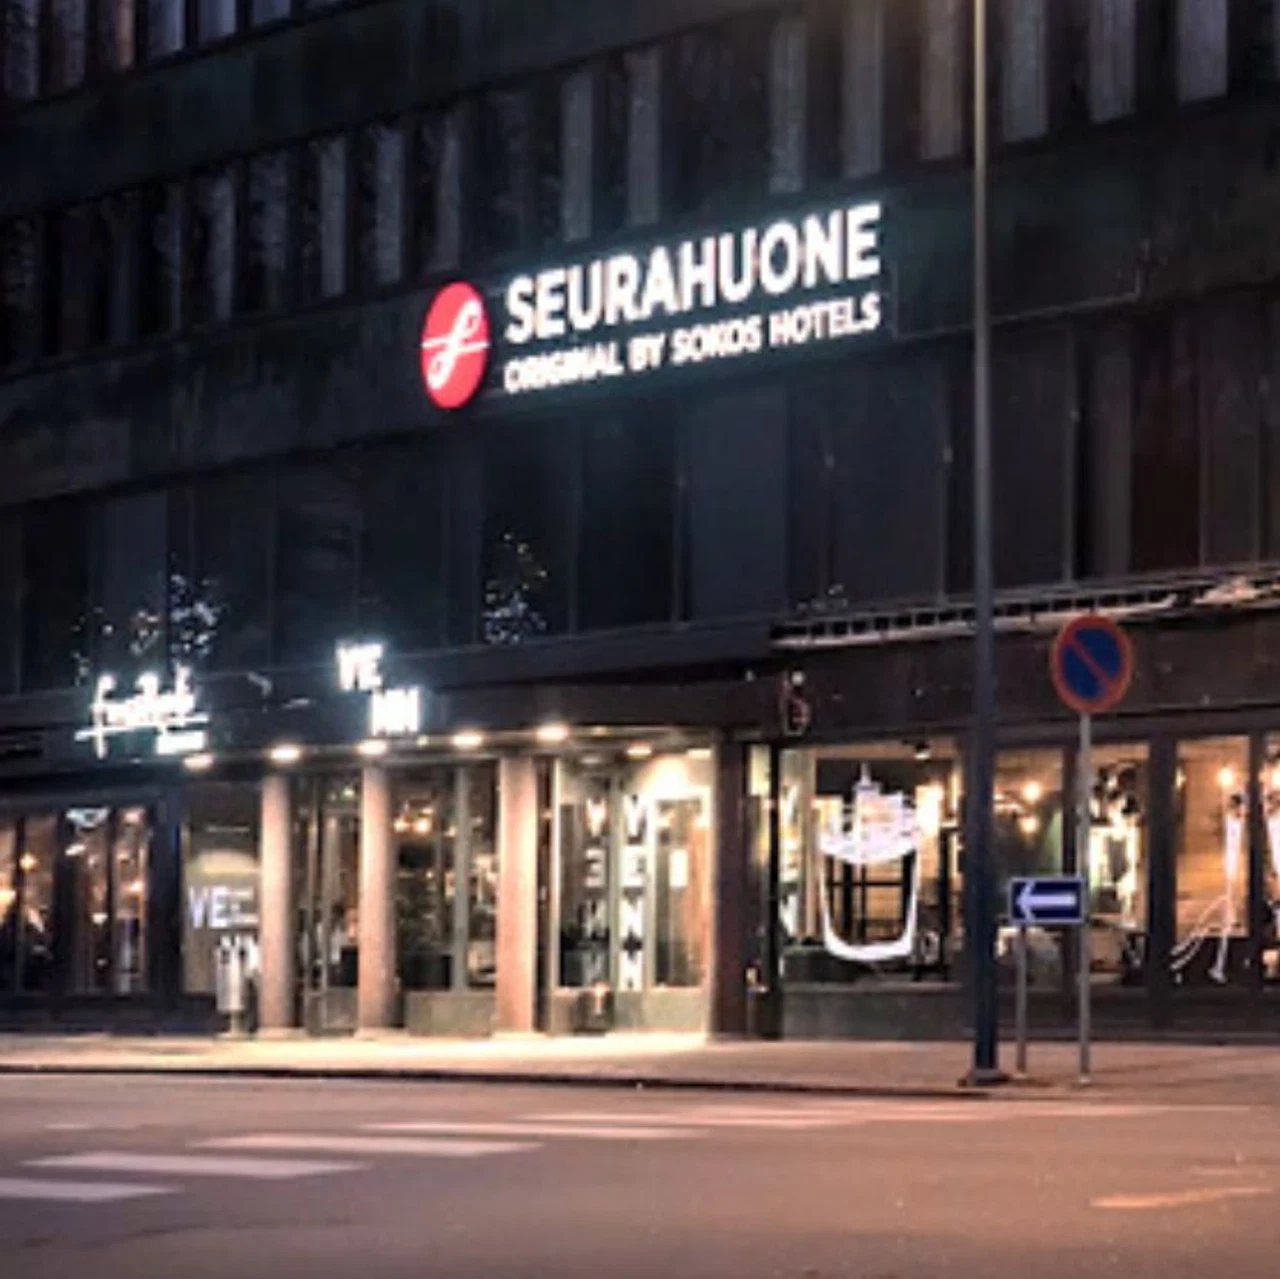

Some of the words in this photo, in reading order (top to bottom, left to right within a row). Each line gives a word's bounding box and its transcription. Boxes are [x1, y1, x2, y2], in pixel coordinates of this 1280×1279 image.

[504, 202, 882, 344] SEURAHUONE
[504, 341, 624, 393] ORIGINAL
[628, 331, 667, 372] BY
[670, 315, 762, 364] SOKOS
[769, 292, 881, 347] HOTELS
